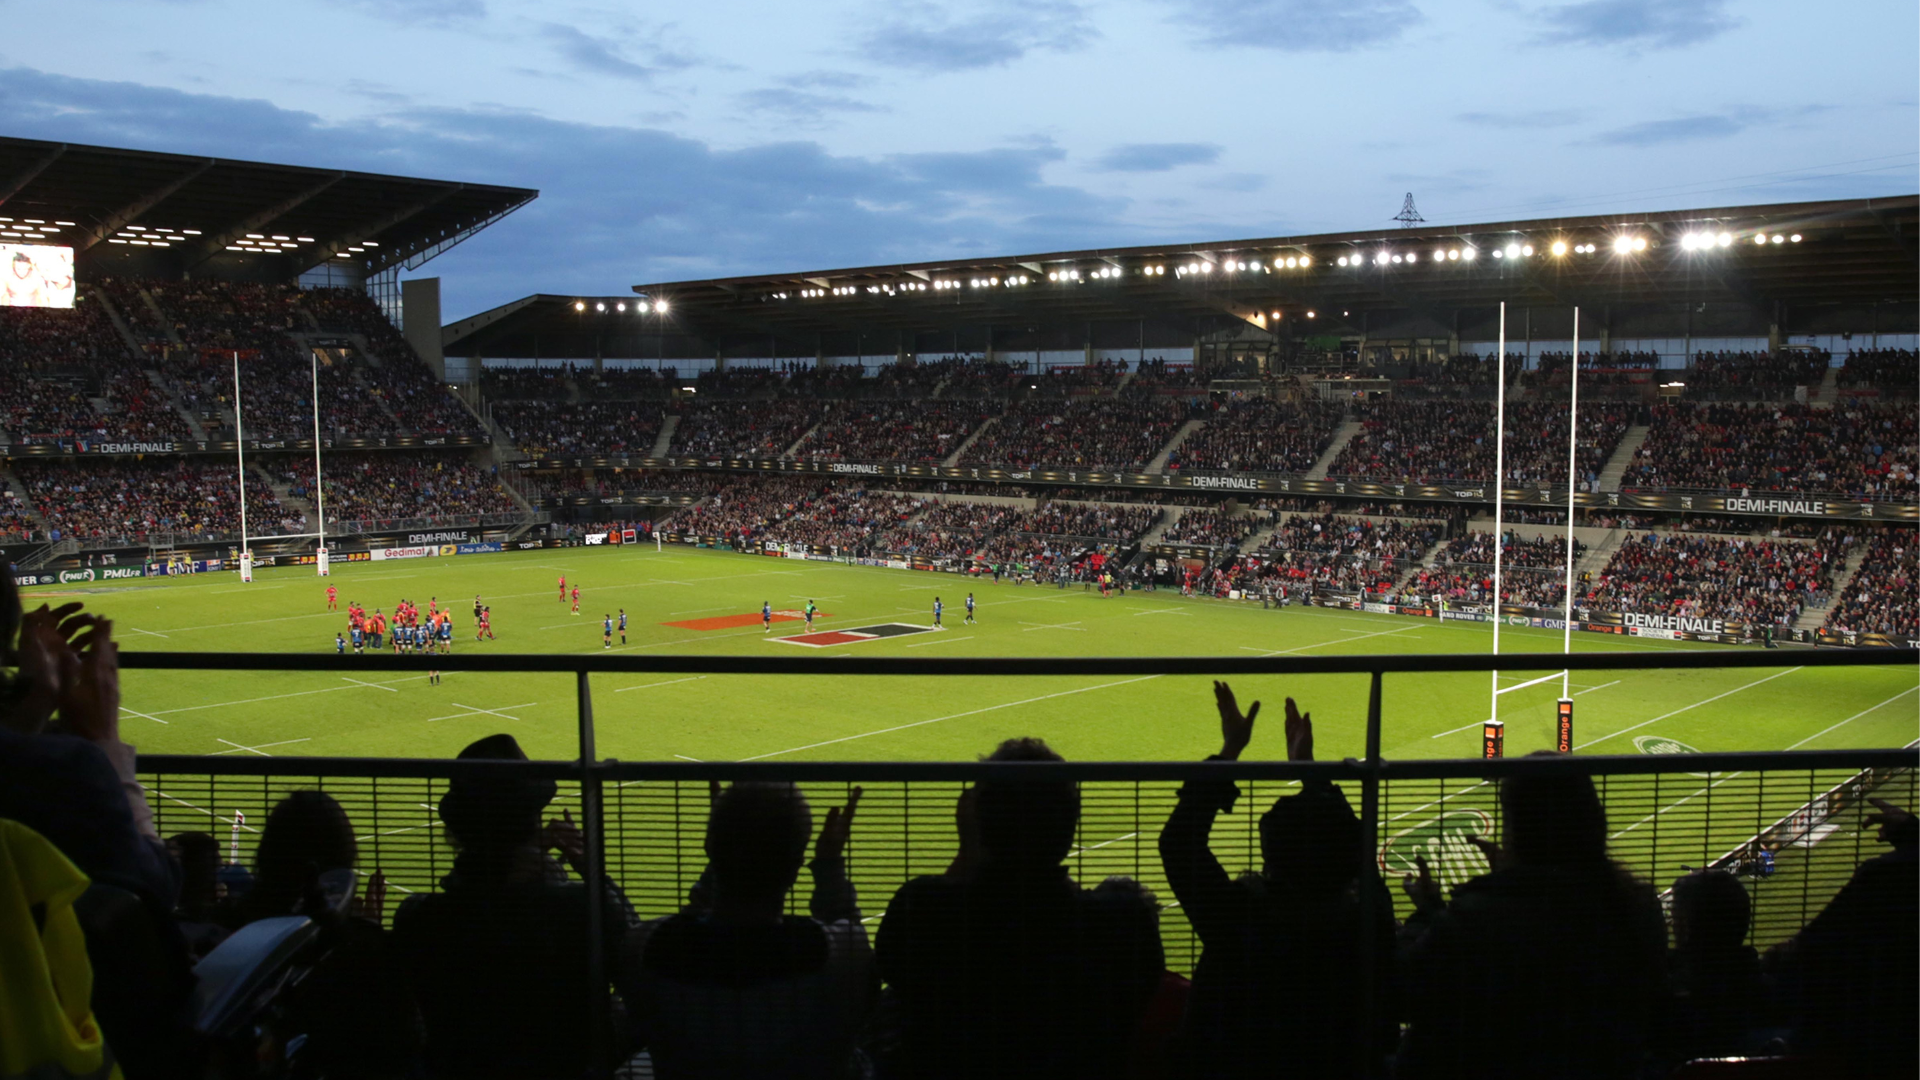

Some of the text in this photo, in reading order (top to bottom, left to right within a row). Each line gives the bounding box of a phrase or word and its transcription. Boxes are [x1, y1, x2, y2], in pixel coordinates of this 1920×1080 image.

[101, 442, 173, 454] DEMI-FINALE
[833, 463, 878, 474] DEMI-FINALE
[1192, 476, 1257, 489] DEMI-FINALE
[1726, 498, 1823, 515] DEMI-FINALE
[409, 531, 468, 544] DEMI-FINALE
[384, 547, 426, 558] Gedimat
[15, 575, 37, 586] VER
[1402, 607, 1424, 616] Orange
[1455, 612, 1475, 621] ROVER
[1544, 618, 1566, 630] GMF
[1587, 623, 1612, 633] Orange
[1624, 612, 1722, 634] DEMI-FINALE
[1559, 716, 1570, 752] Orange
[1486, 741, 1495, 760] nge
